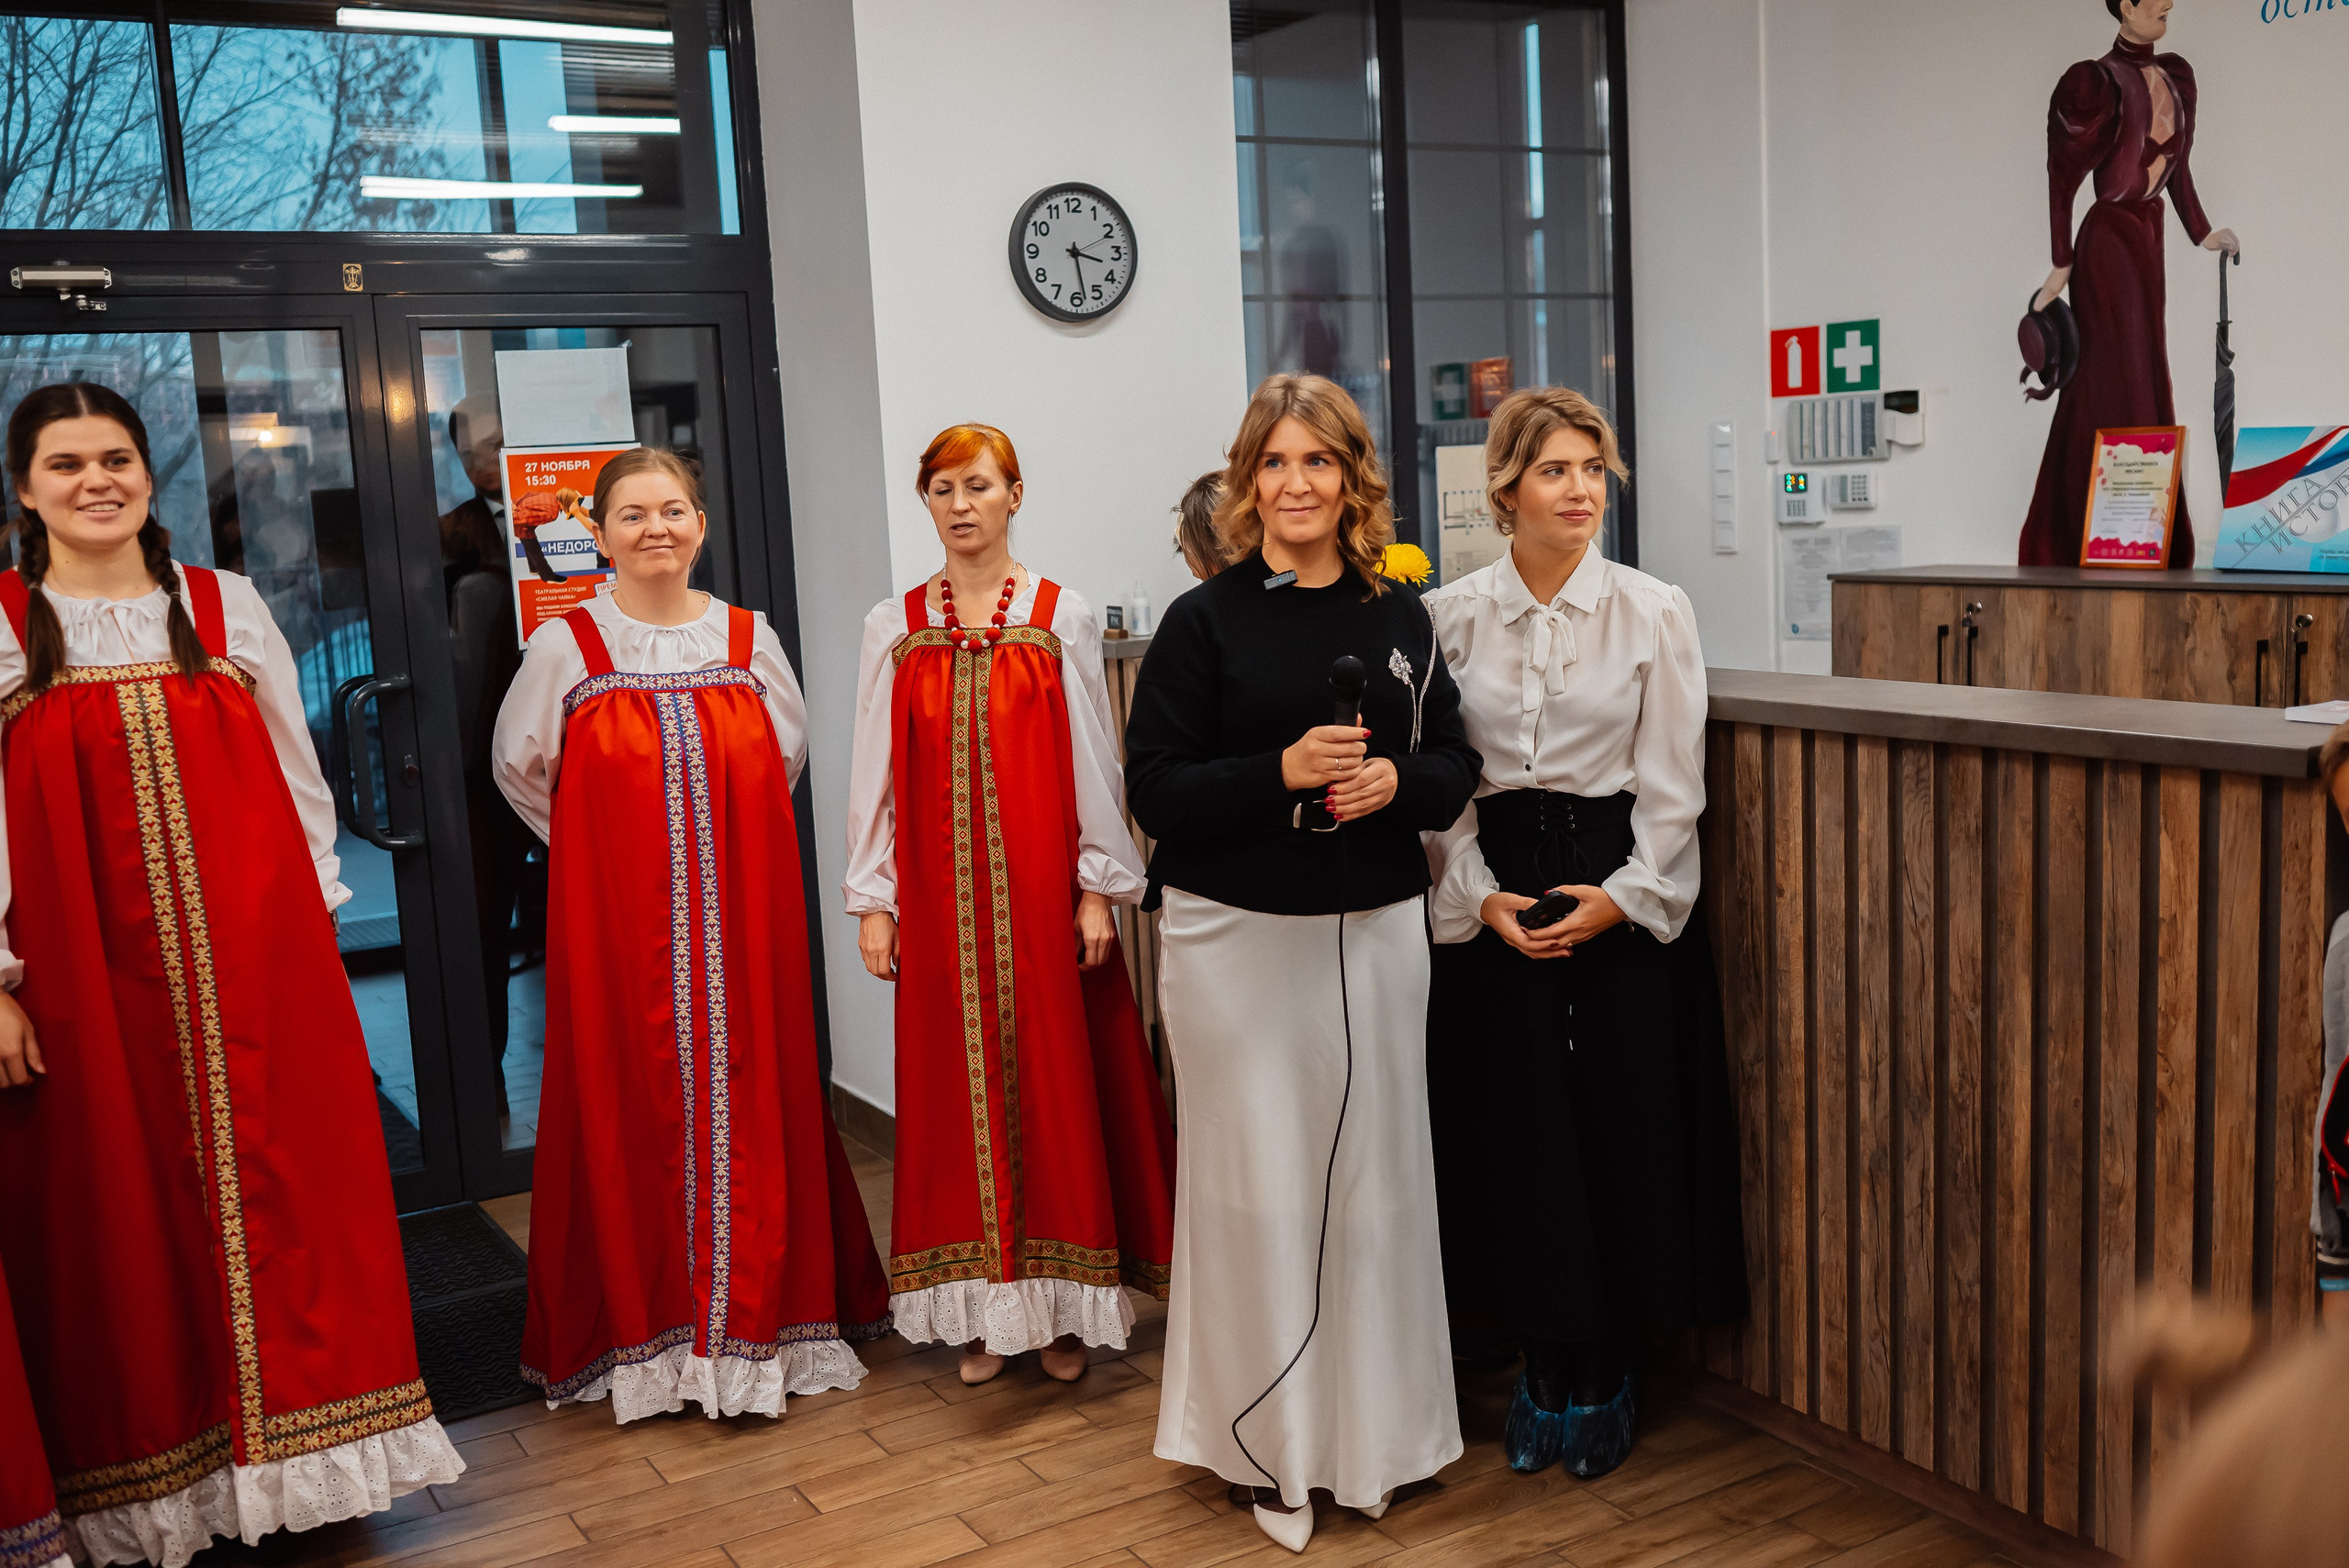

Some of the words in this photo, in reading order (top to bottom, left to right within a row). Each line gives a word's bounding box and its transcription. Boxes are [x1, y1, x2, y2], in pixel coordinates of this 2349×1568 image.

[1046, 204, 1059, 219] 11
[1063, 197, 1082, 213] 12
[1090, 206, 1097, 221] 1
[1031, 220, 1050, 237] 10
[1102, 223, 1114, 239] 2
[1026, 243, 1040, 260] 9
[1110, 245, 1122, 261] 3
[1035, 267, 1047, 283] 8
[1104, 269, 1117, 284] 4
[1051, 284, 1063, 300] 7
[1070, 292, 1084, 307] 6
[1091, 284, 1103, 300] 5
[525, 462, 538, 473] 27
[540, 460, 590, 472] НОЯБРЯ
[525, 474, 556, 486] 15:30
[2235, 477, 2322, 553] КНИГА
